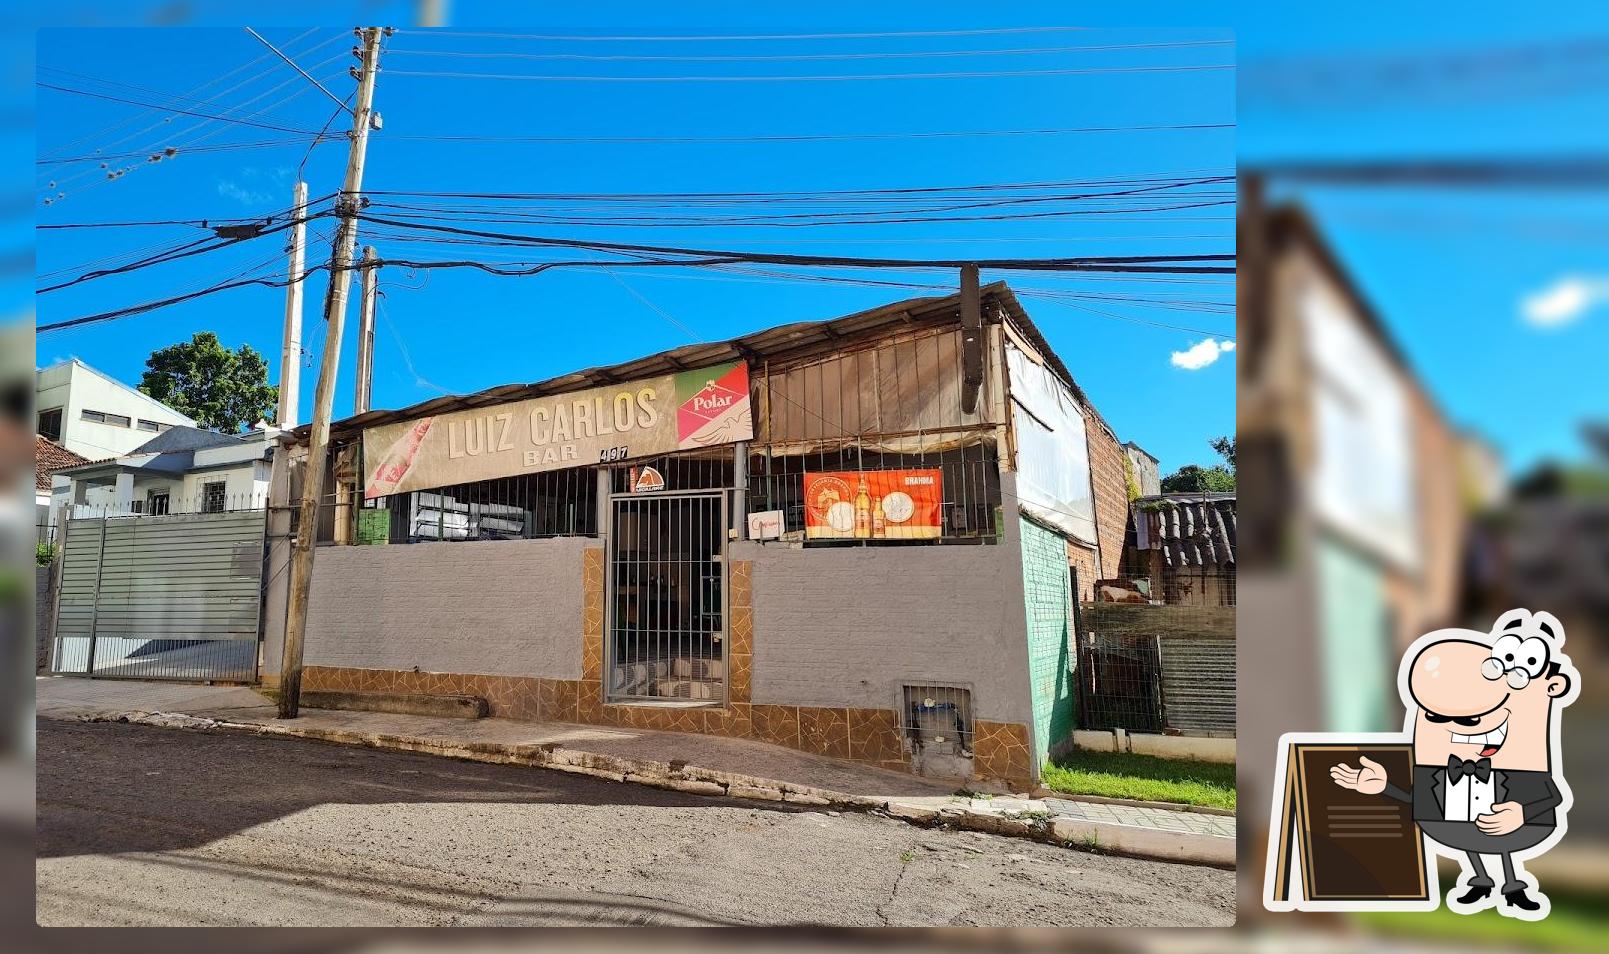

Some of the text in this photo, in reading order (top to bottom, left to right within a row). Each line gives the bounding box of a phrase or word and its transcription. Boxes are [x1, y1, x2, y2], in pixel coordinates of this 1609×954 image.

[693, 394, 733, 411] Polar
[448, 388, 659, 459] LUIZ CARLOS
[523, 444, 578, 467] BAR
[600, 446, 628, 462] 497
[904, 476, 934, 486] BRAHMA
